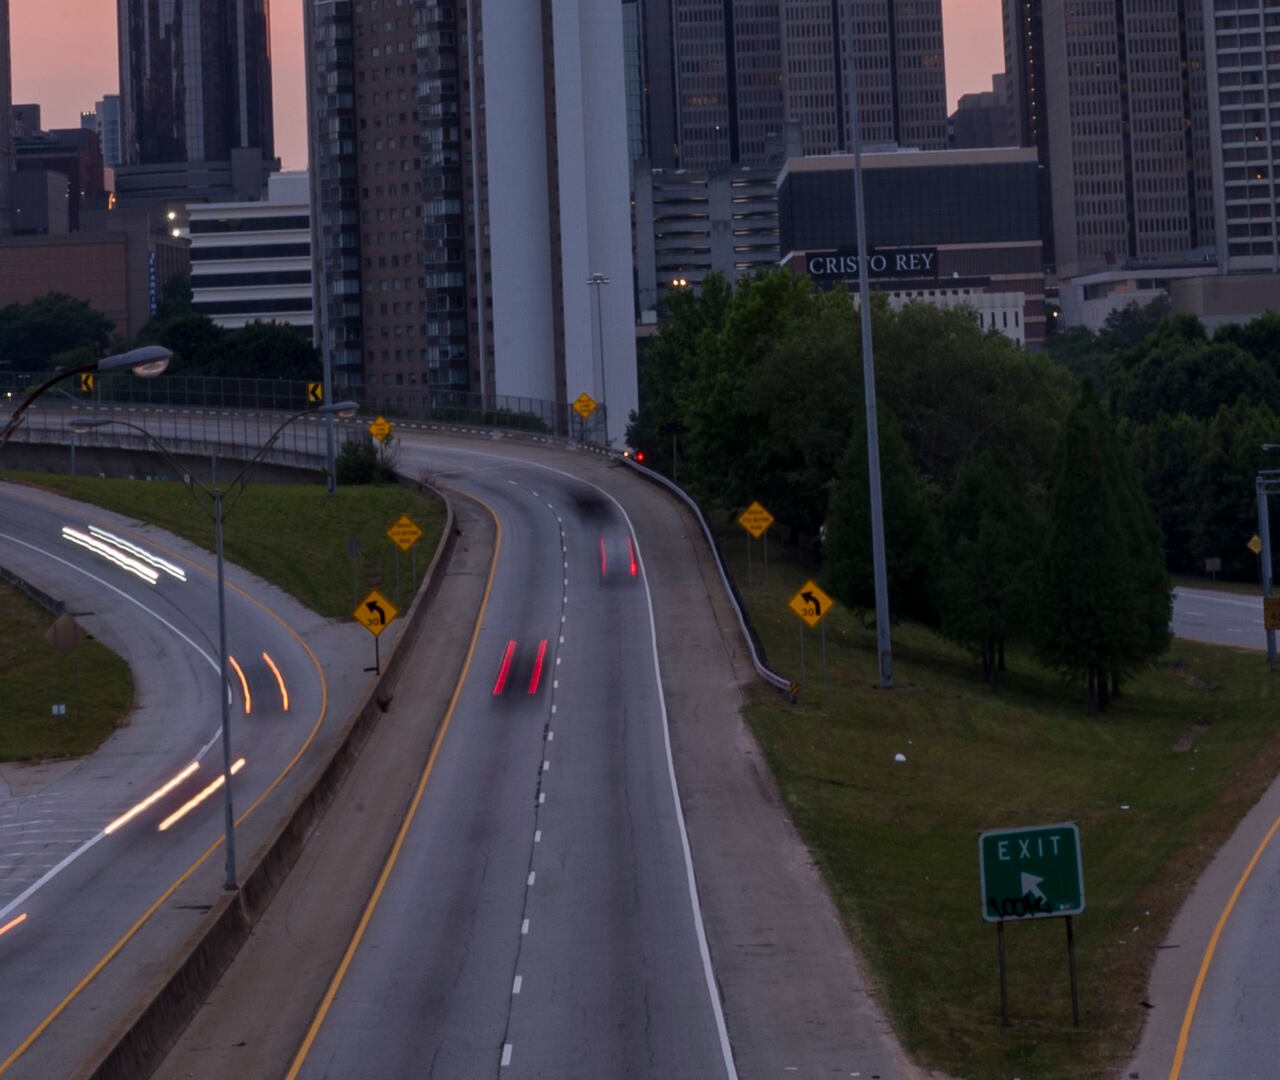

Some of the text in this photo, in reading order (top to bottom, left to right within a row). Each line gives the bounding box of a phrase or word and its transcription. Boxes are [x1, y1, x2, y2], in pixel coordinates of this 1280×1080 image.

[896, 253, 934, 271] REY
[367, 617, 379, 626] 30
[998, 836, 1061, 861] EXIT
